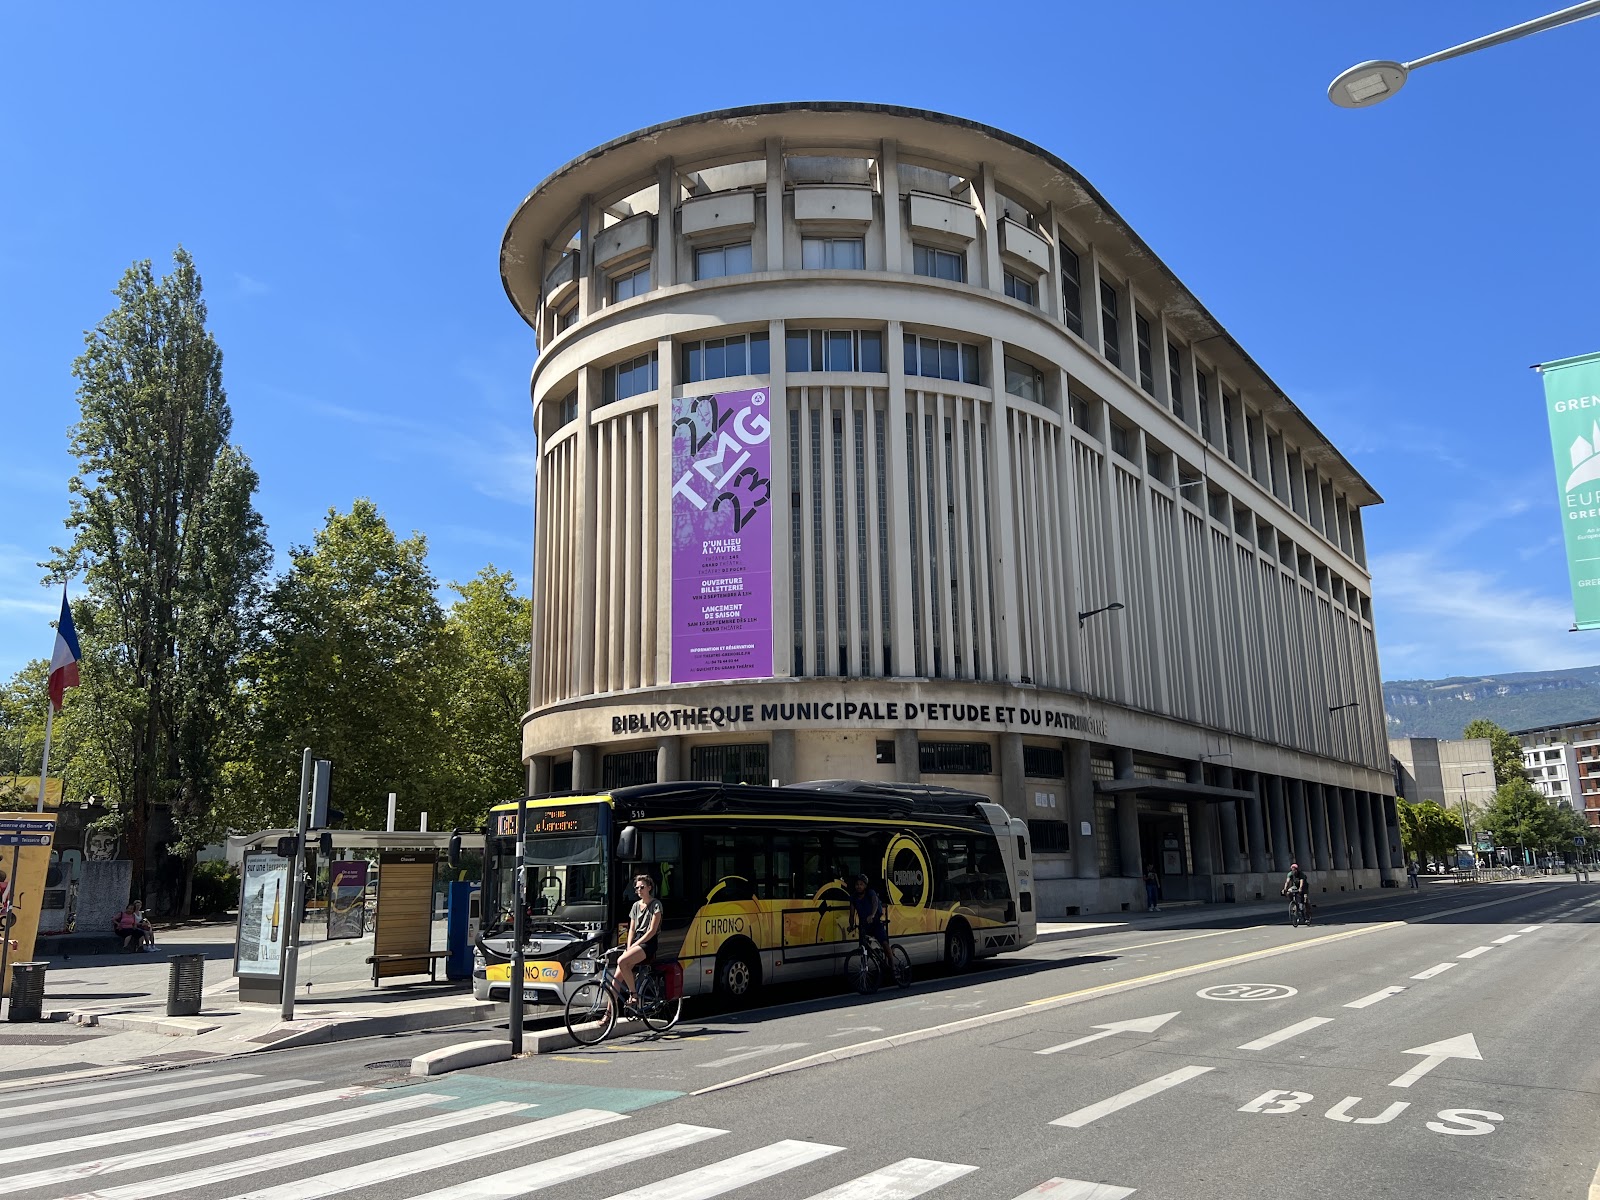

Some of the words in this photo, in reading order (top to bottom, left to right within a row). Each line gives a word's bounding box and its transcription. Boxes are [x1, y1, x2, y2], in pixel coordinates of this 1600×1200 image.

[672, 406, 770, 510] TMG
[703, 540, 722, 548] D'UN
[709, 545, 741, 554] L'AUTRE
[702, 577, 742, 586] OUVERTURE
[701, 584, 744, 593] BILLETTERIE
[702, 604, 743, 613] LANCEMENT
[612, 705, 754, 732] BIBLIOTHEQUE
[761, 702, 898, 722] MUNICIPALE
[905, 703, 991, 722] D'ETUDE
[996, 706, 1016, 724] ET
[1020, 708, 1042, 726] DU
[632, 810, 645, 818] 519
[584, 922, 602, 931] 519
[706, 917, 744, 935] CHRONO
[541, 967, 559, 978] Tag
[1212, 986, 1276, 998] 30
[1237, 1089, 1505, 1136] BUS
